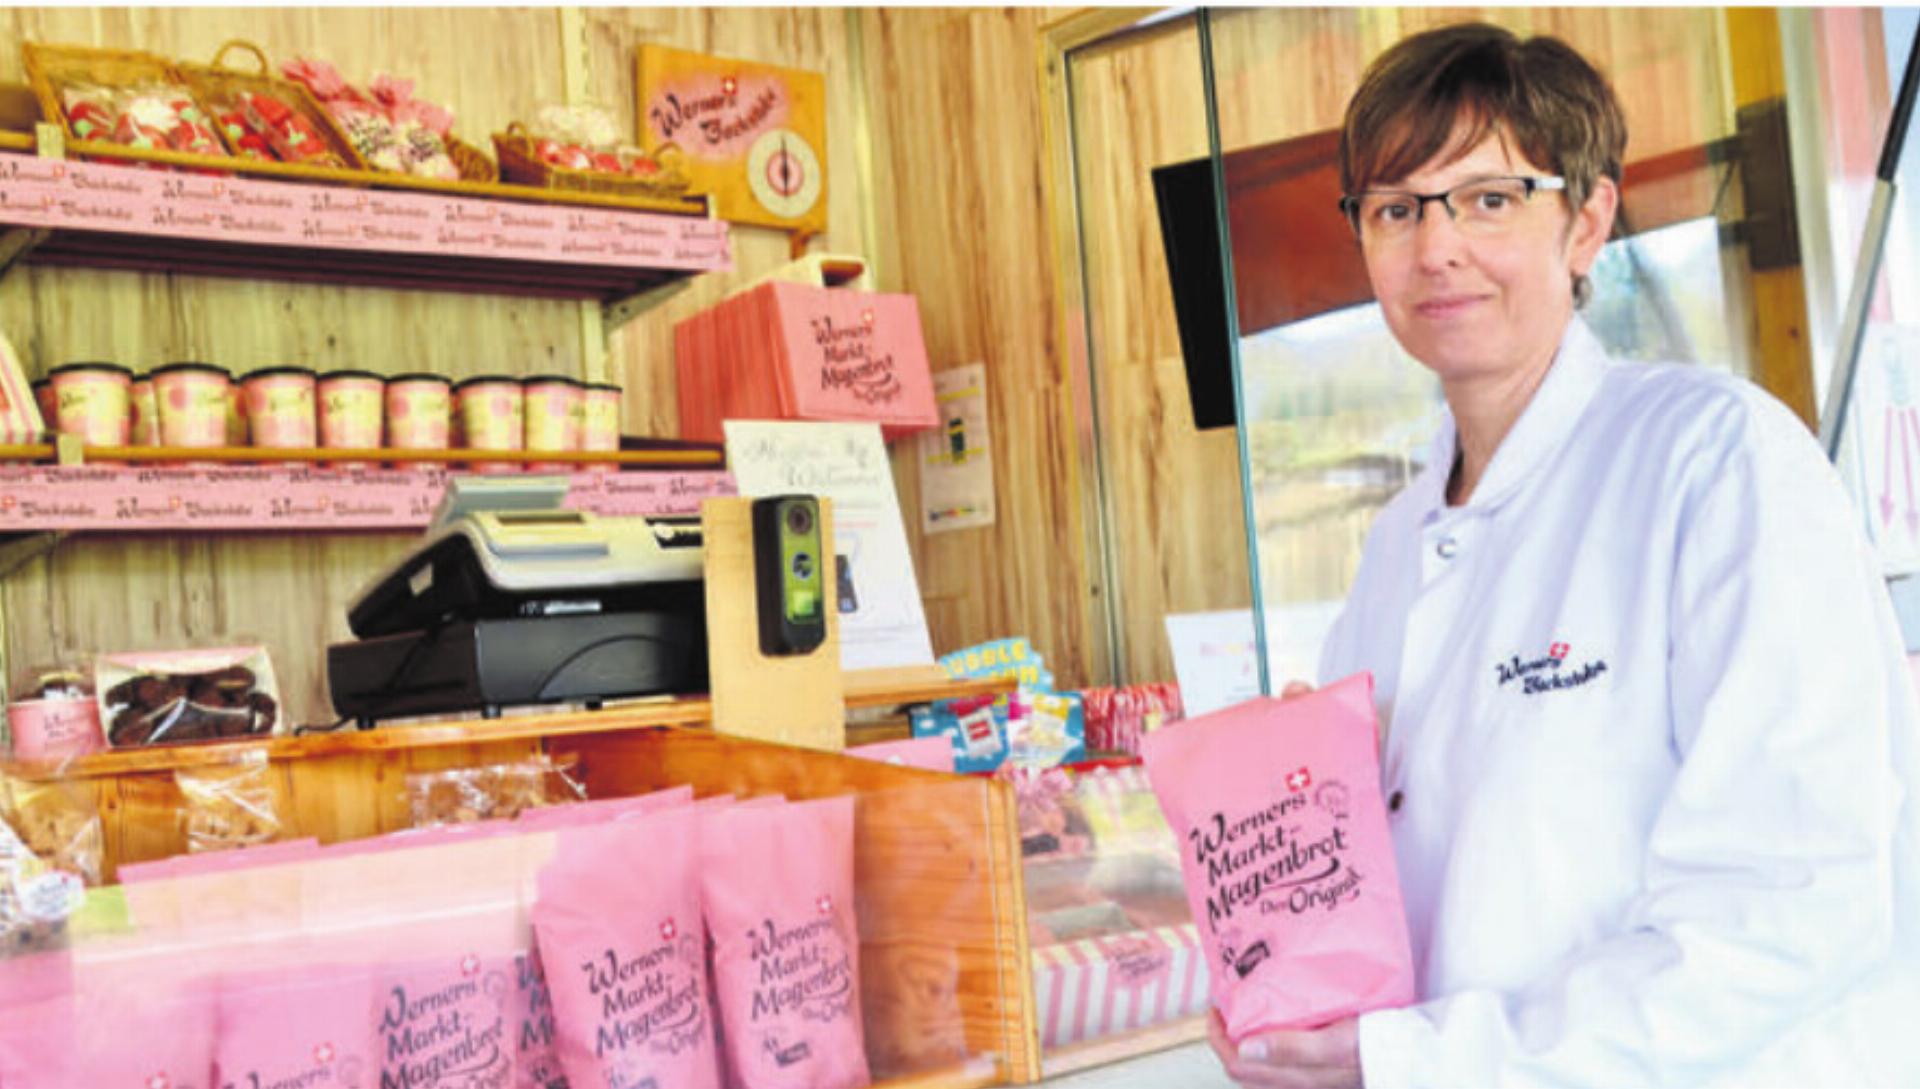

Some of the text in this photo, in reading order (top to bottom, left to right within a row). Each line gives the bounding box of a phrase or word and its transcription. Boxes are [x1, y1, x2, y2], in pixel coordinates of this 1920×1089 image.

[1189, 794, 1309, 865] Werners
[1207, 825, 1303, 888] Markt-
[1206, 826, 1350, 935] Magenbrot
[1289, 867, 1362, 915] Original
[746, 919, 833, 962] Werners
[760, 945, 830, 986] Markt-
[580, 946, 676, 994] Werners
[603, 968, 675, 1020] Markt-
[751, 951, 851, 1022] Magenbrot
[597, 975, 701, 1059] Magenbrot
